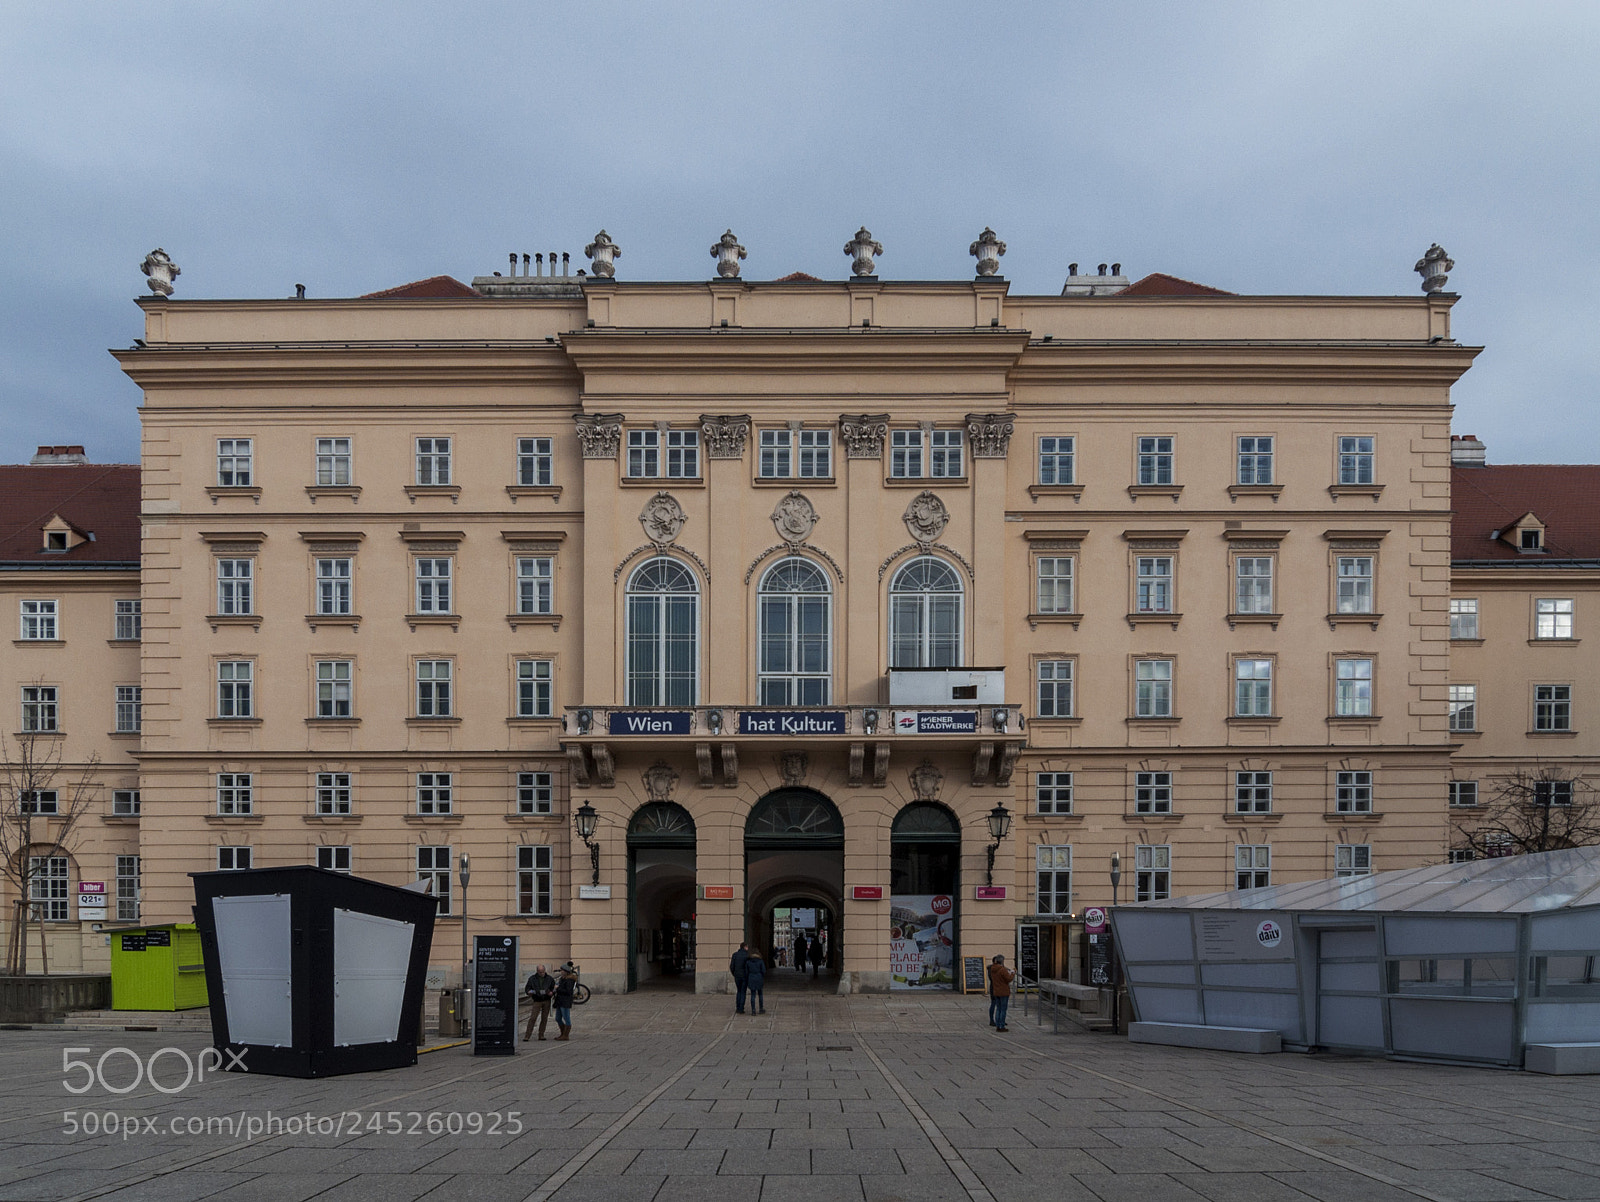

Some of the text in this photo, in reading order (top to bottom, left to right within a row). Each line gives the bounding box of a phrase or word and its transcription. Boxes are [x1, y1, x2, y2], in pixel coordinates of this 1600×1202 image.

[627, 716, 673, 731] Wien
[747, 715, 837, 732] hat Kultur.
[920, 722, 974, 730] STADTWERKE
[932, 898, 951, 909] MQ
[1258, 928, 1280, 942] daily
[890, 942, 905, 952] MY
[890, 953, 924, 962] PLACE
[890, 963, 920, 973] TO BE
